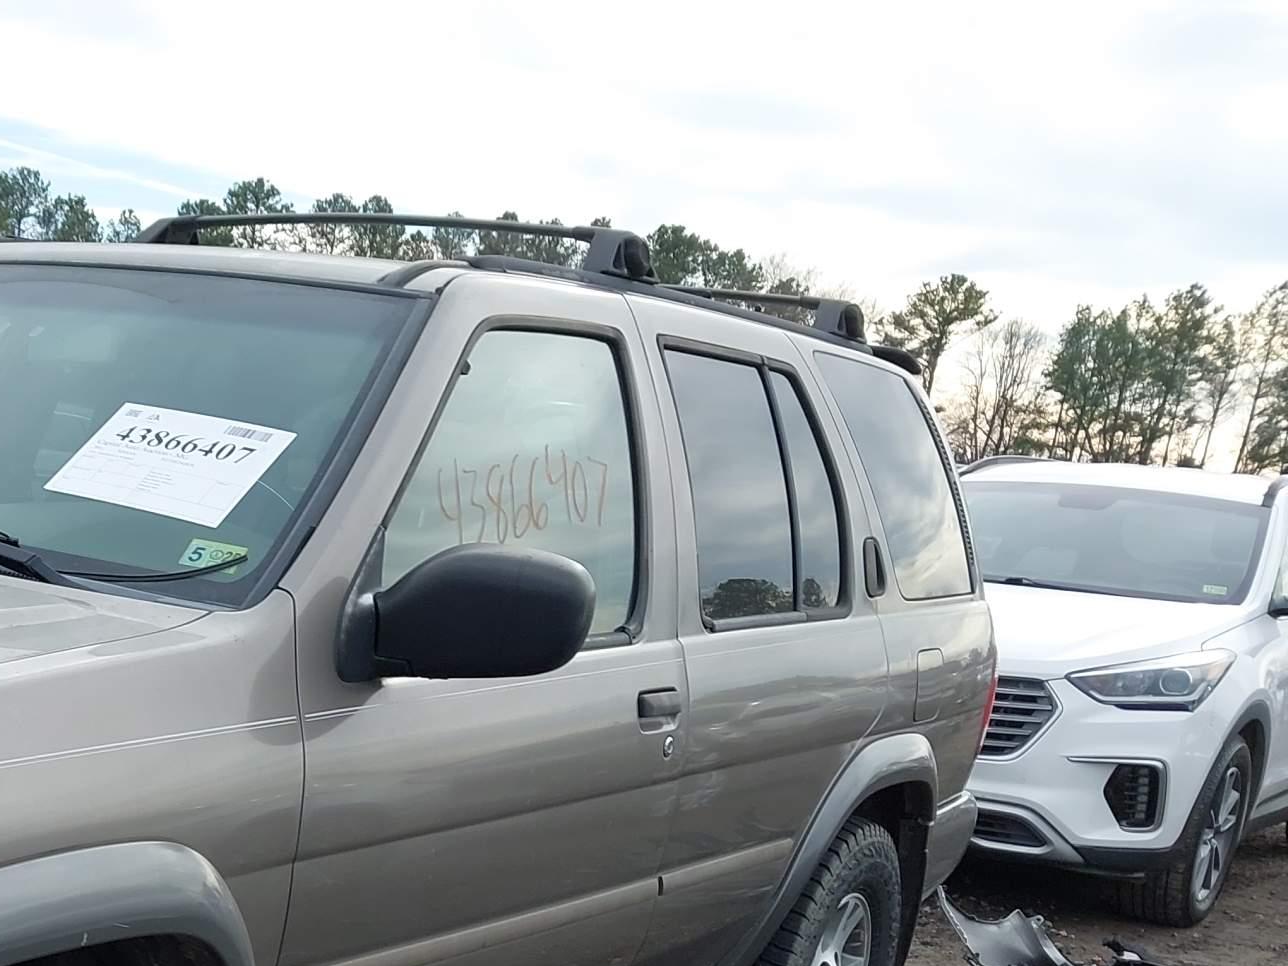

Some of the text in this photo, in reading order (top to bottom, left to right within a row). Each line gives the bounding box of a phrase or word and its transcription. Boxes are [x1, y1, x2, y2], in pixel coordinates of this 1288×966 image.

[115, 424, 258, 464] 43866407
[438, 443, 609, 545] 43866407
[187, 545, 206, 563] 5
